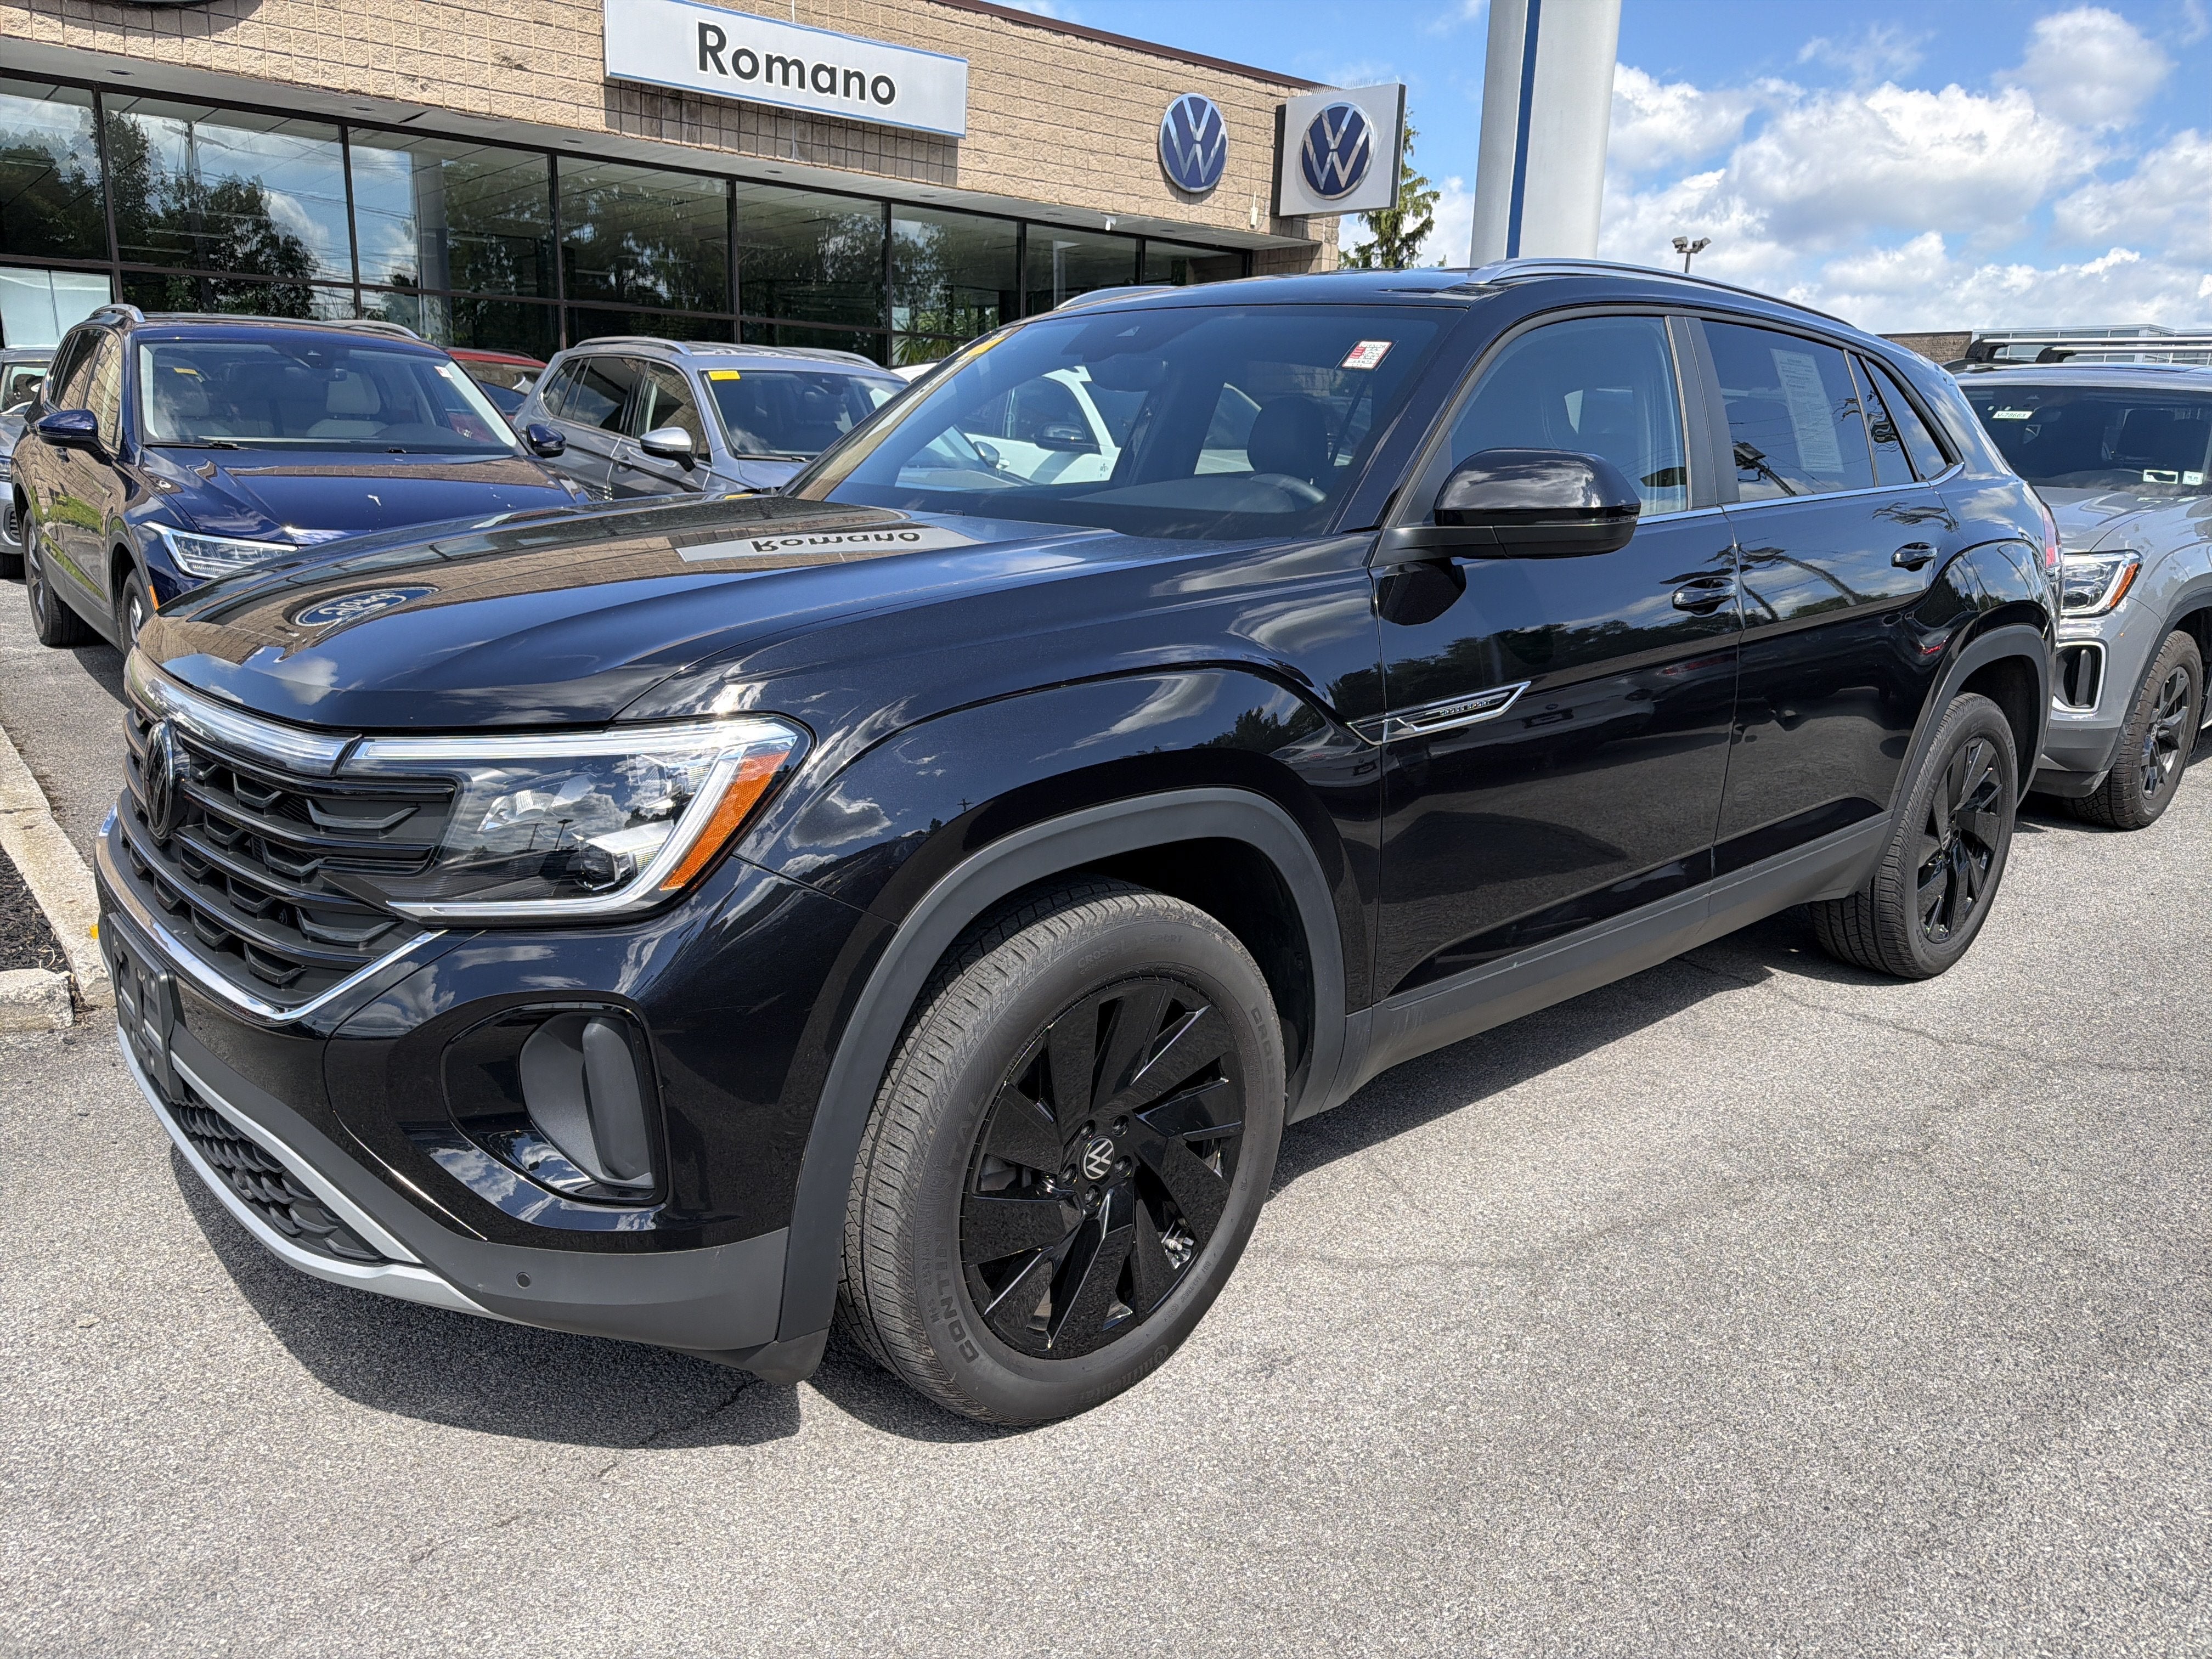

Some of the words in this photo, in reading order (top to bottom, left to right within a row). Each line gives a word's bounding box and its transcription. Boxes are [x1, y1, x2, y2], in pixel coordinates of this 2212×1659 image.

[697, 21, 897, 107] Romano
[1159, 92, 1229, 193] VW
[1301, 101, 1374, 200] VW
[933, 1092, 985, 1363] CONTINENTAL
